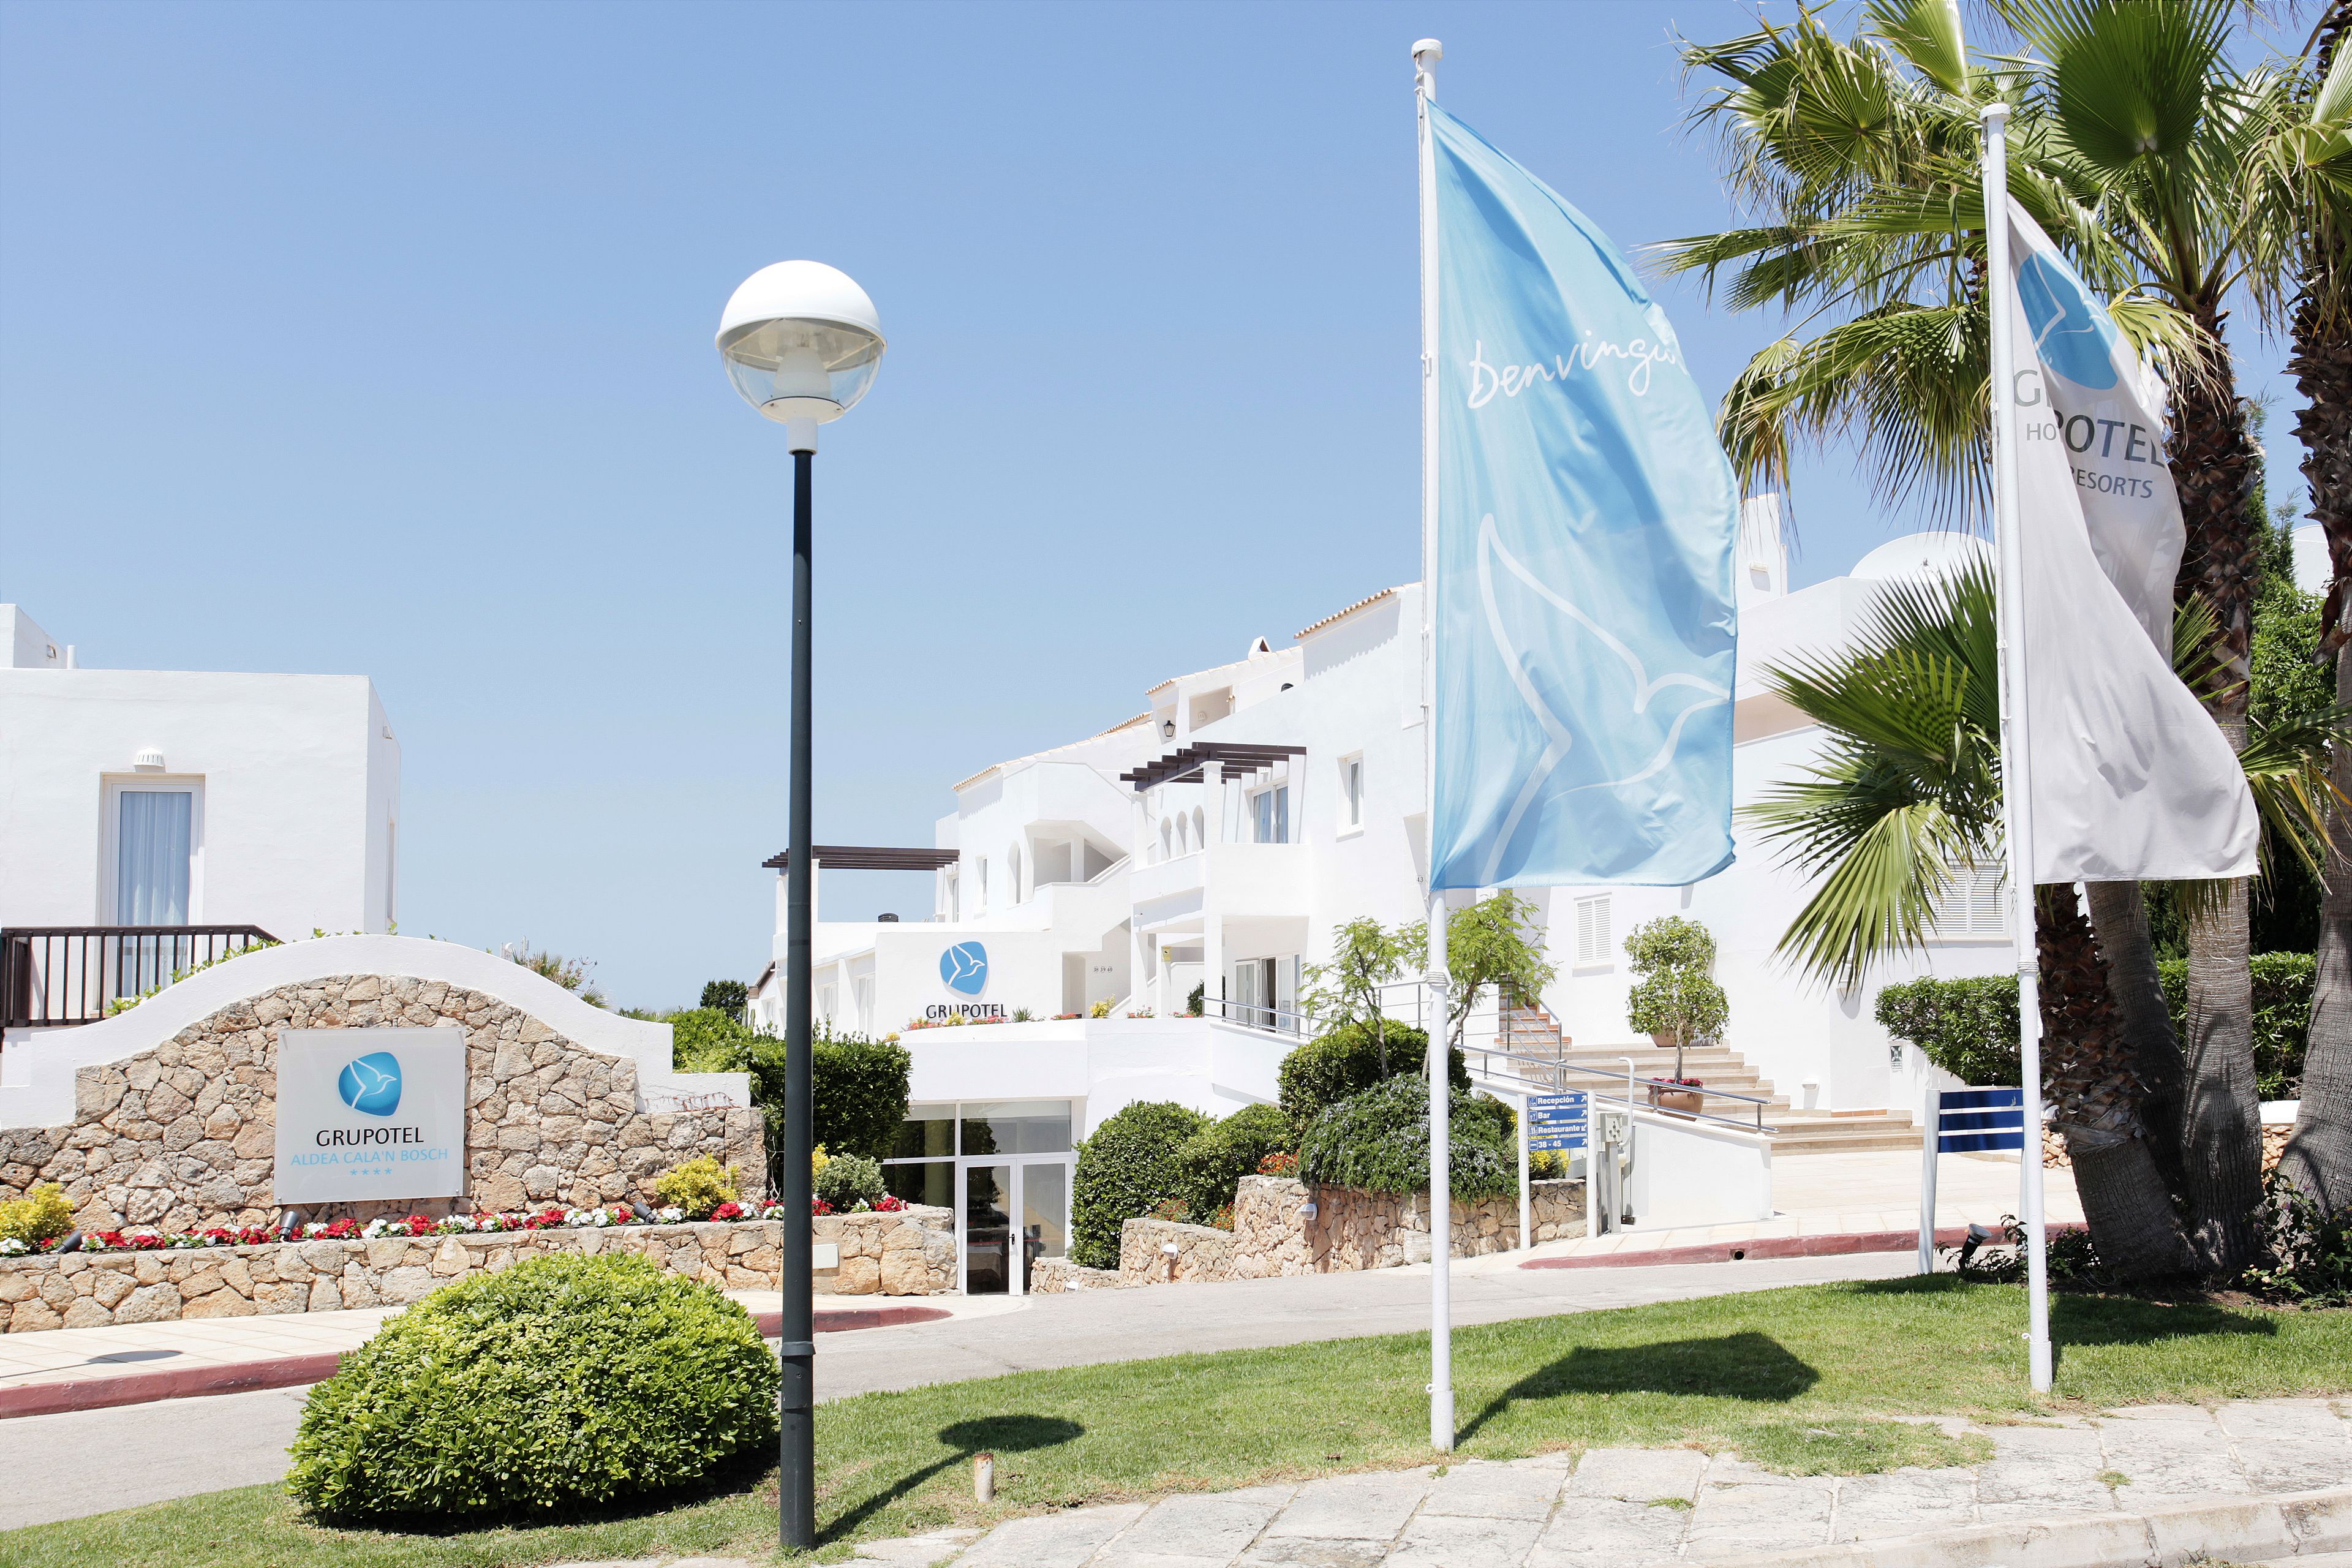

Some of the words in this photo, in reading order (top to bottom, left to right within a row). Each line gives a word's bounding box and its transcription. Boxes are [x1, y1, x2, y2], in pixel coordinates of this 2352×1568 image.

[2070, 466, 2153, 499] ESORTS
[1537, 1096, 1574, 1105] Recepción
[316, 1127, 424, 1147] GRUPOTEL
[1538, 1125, 1580, 1134] Restaurante
[290, 1152, 339, 1166] ALDEA
[344, 1150, 395, 1164] CALA'N
[401, 1148, 448, 1162] BOSCH
